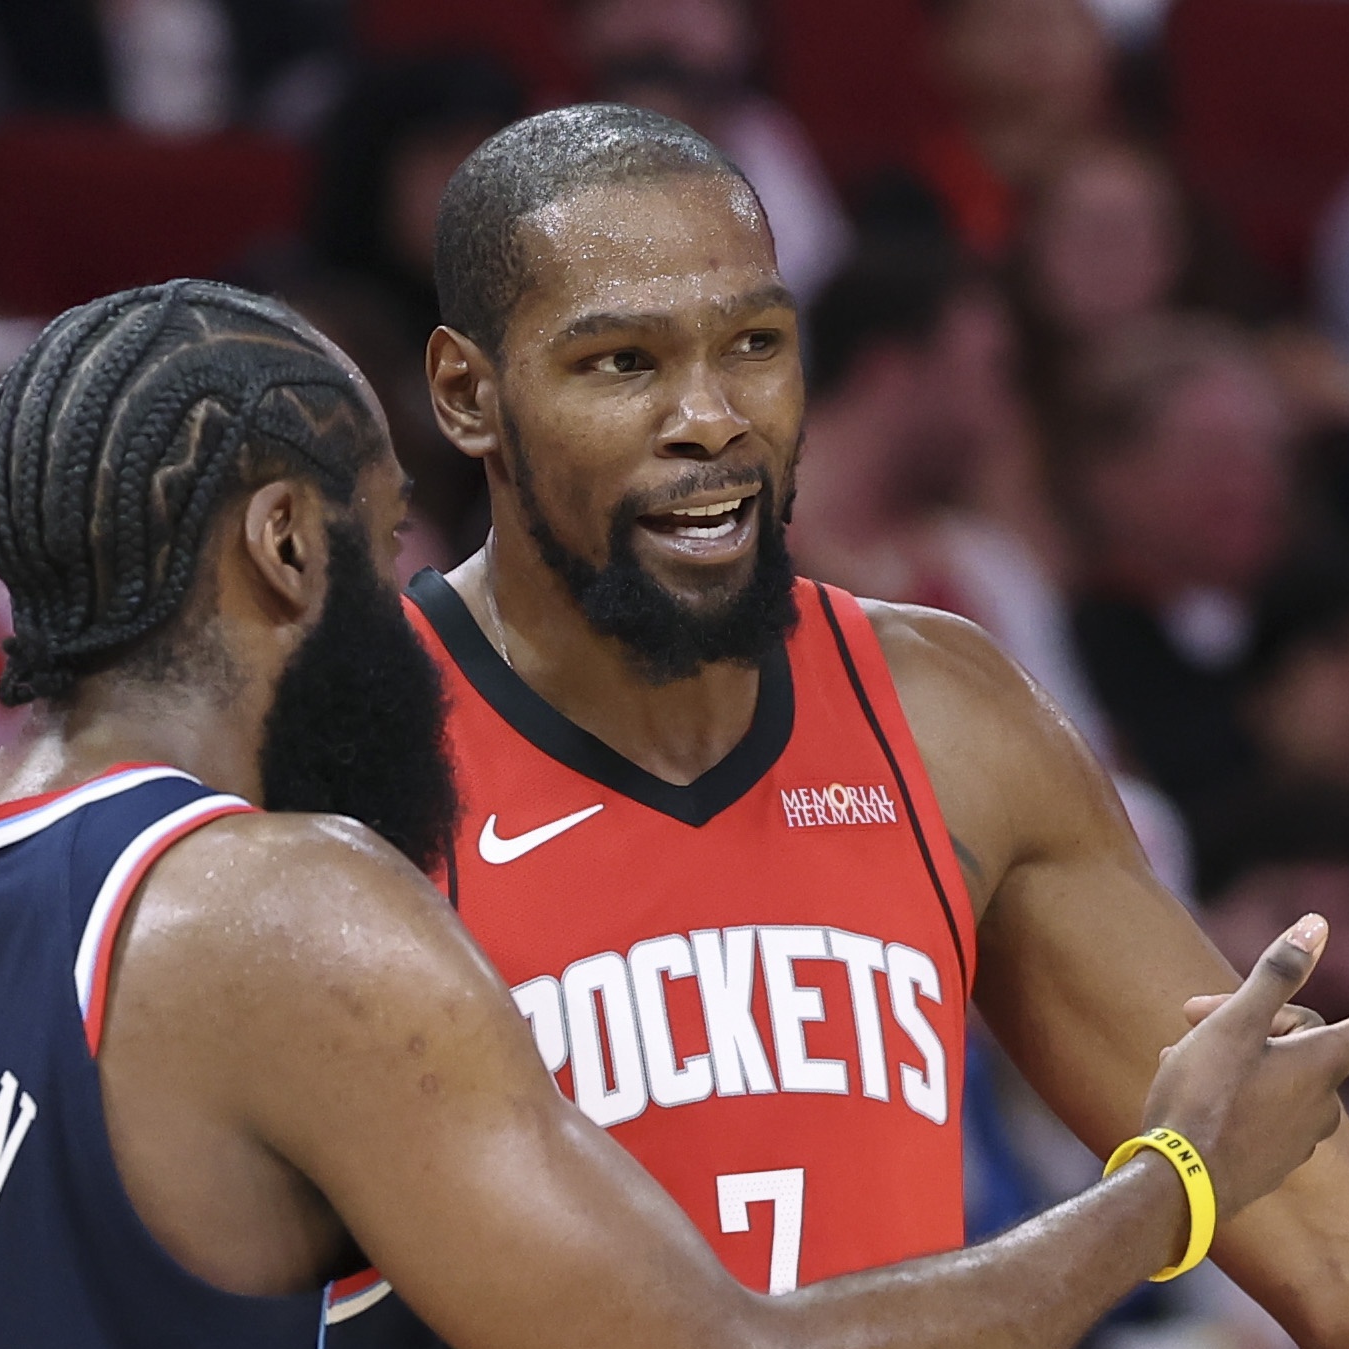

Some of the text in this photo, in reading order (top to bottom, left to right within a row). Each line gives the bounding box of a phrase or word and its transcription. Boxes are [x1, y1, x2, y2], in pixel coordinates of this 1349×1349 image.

[780, 782, 894, 809] MEMORIAL
[785, 803, 897, 827] HERMANN
[716, 1168, 804, 1296] 7
